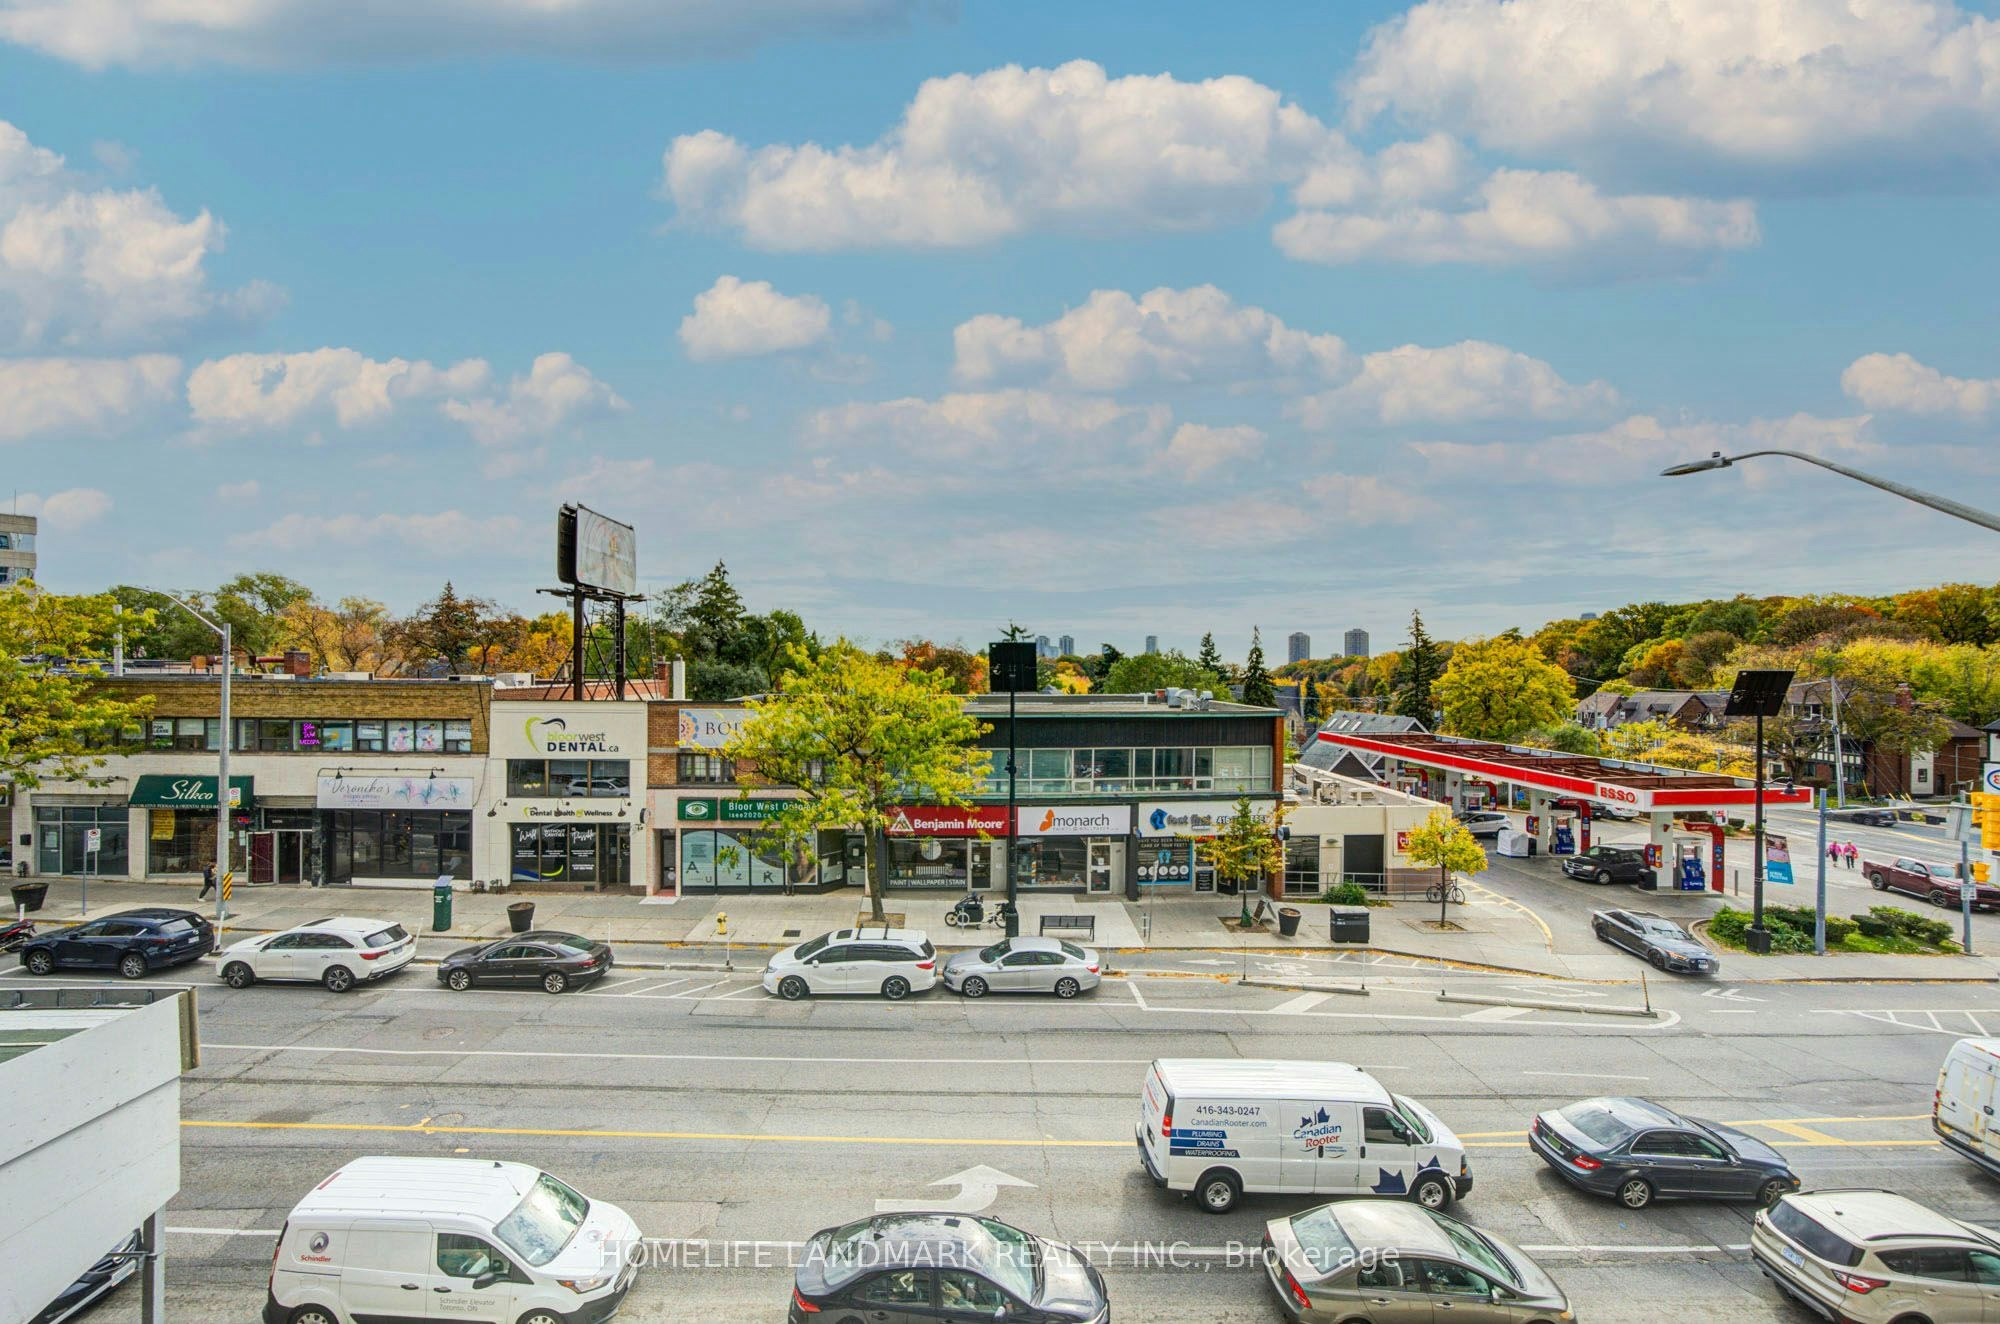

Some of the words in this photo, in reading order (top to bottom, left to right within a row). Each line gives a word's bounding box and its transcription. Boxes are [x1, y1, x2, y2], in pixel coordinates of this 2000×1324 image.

[547, 742, 619, 752] DENTAL.ca
[161, 780, 214, 800] Silkco
[1600, 786, 1637, 803] ESSO
[729, 803, 752, 811] Bloor
[757, 803, 779, 811] West
[914, 819, 965, 831] Benjamin
[967, 819, 1002, 829] Moore
[1053, 814, 1110, 826] monarch
[686, 861, 700, 873] A
[763, 871, 774, 883] K
[1196, 1106, 1260, 1115] 416-343-0247
[1191, 1119, 1267, 1127] CanadianRooter.com
[1293, 1125, 1342, 1139] Canadian
[1305, 1135, 1340, 1147] Rooter
[301, 1254, 332, 1262] Schindler
